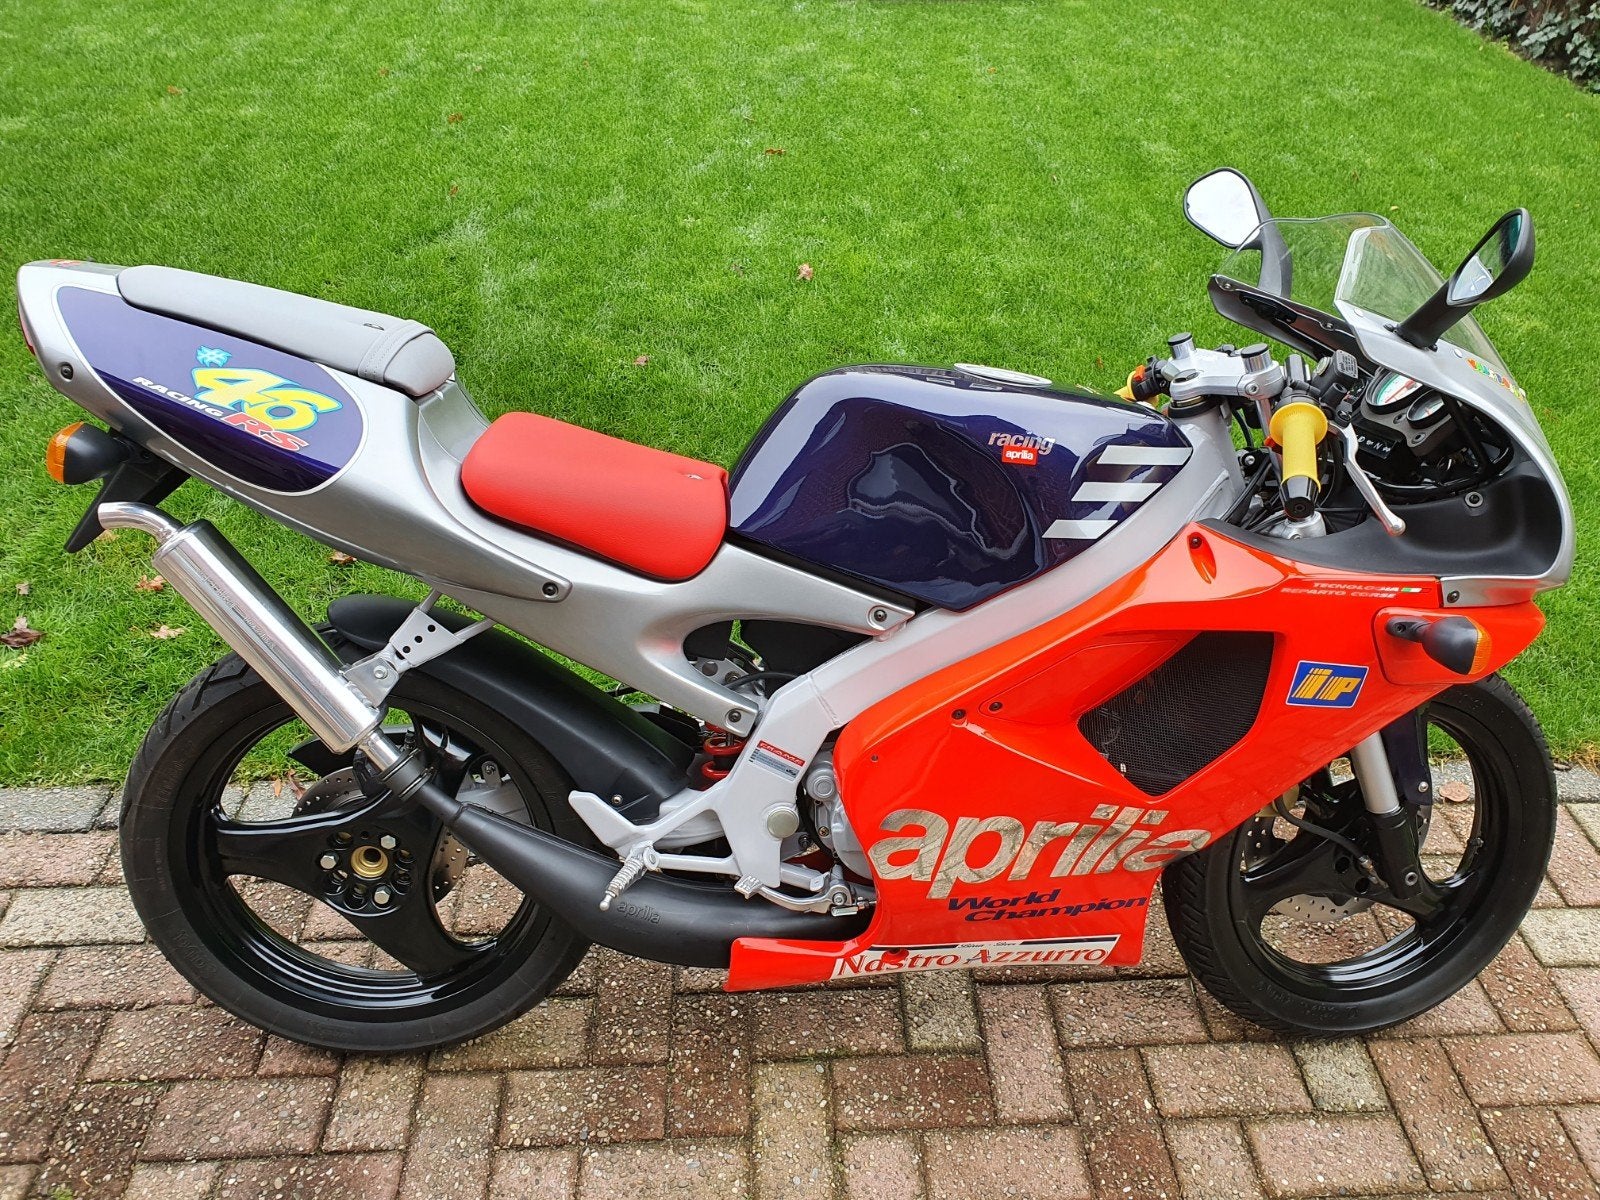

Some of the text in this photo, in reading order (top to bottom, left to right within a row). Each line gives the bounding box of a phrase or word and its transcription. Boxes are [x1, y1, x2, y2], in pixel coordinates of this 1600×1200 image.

[192, 367, 343, 432] 46
[133, 376, 309, 451] RACING RS
[988, 431, 1055, 455] racing
[1005, 450, 1034, 460] aprilia
[1280, 587, 1397, 599] REPARTO CORSE
[868, 803, 1212, 899] aprilia
[948, 888, 1061, 911] World
[964, 896, 1148, 922] Champion
[617, 901, 661, 923] aprilia
[964, 948, 1110, 966] Azzurro
